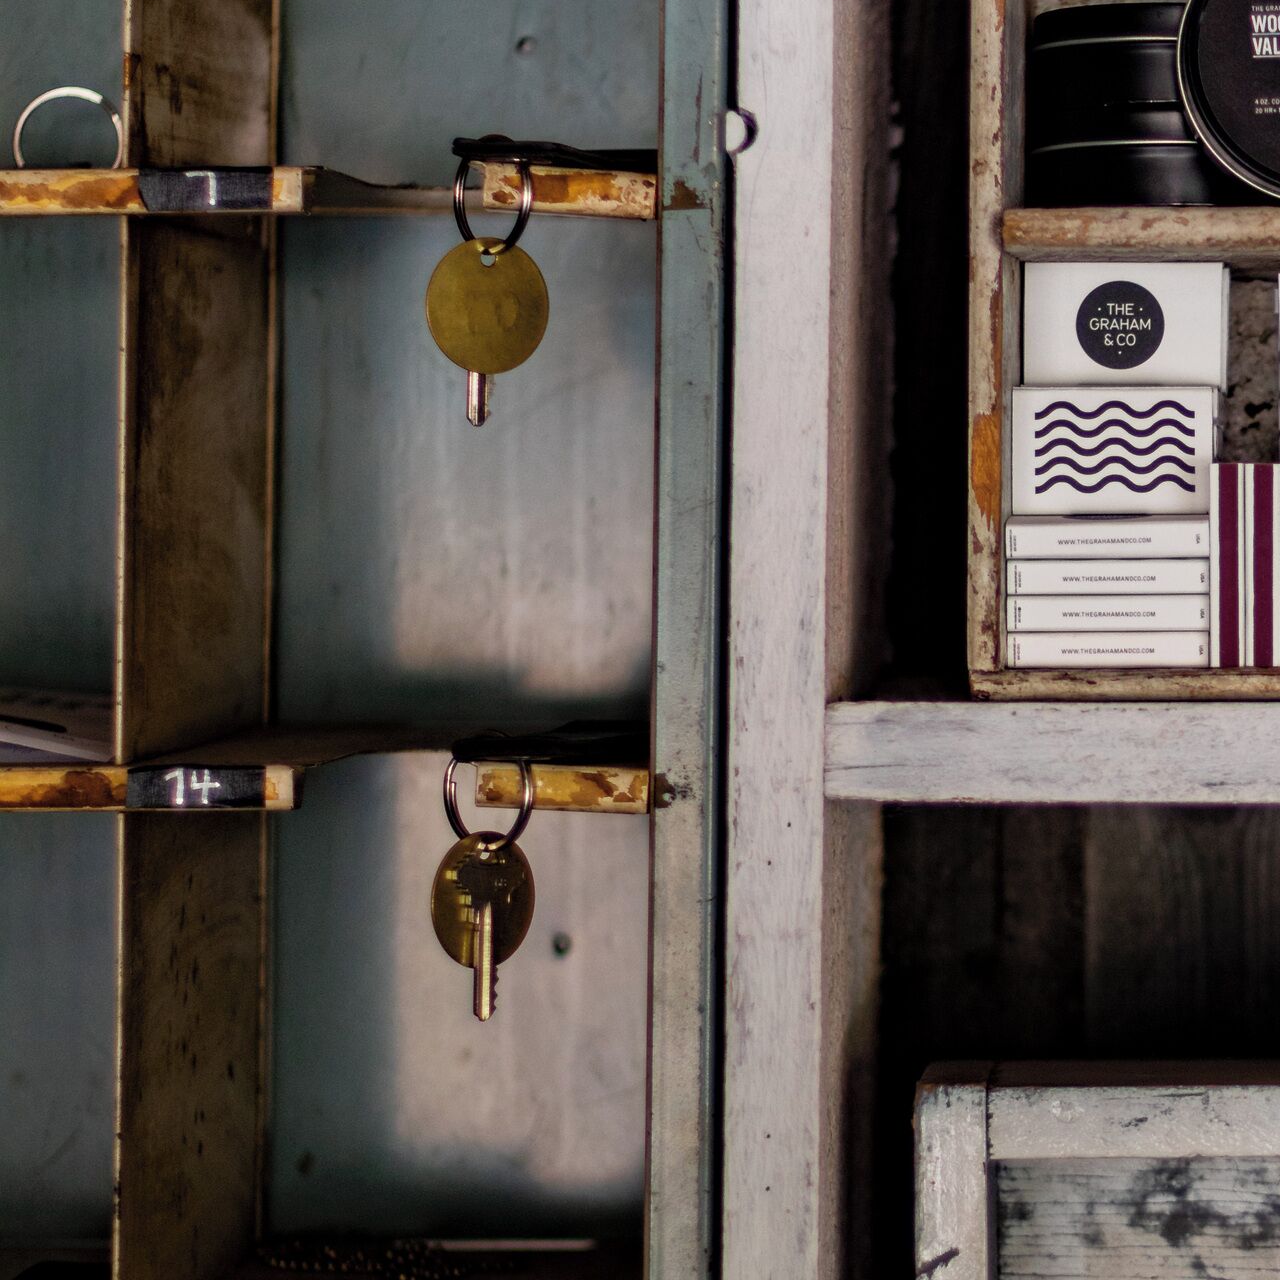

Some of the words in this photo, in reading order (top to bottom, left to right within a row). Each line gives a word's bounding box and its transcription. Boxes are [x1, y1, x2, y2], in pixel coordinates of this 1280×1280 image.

[1107, 303, 1134, 315] THE
[1089, 318, 1151, 330] GRAHAM
[1104, 333, 1113, 346] &
[1116, 333, 1136, 346] CO
[164, 767, 221, 805] 14
